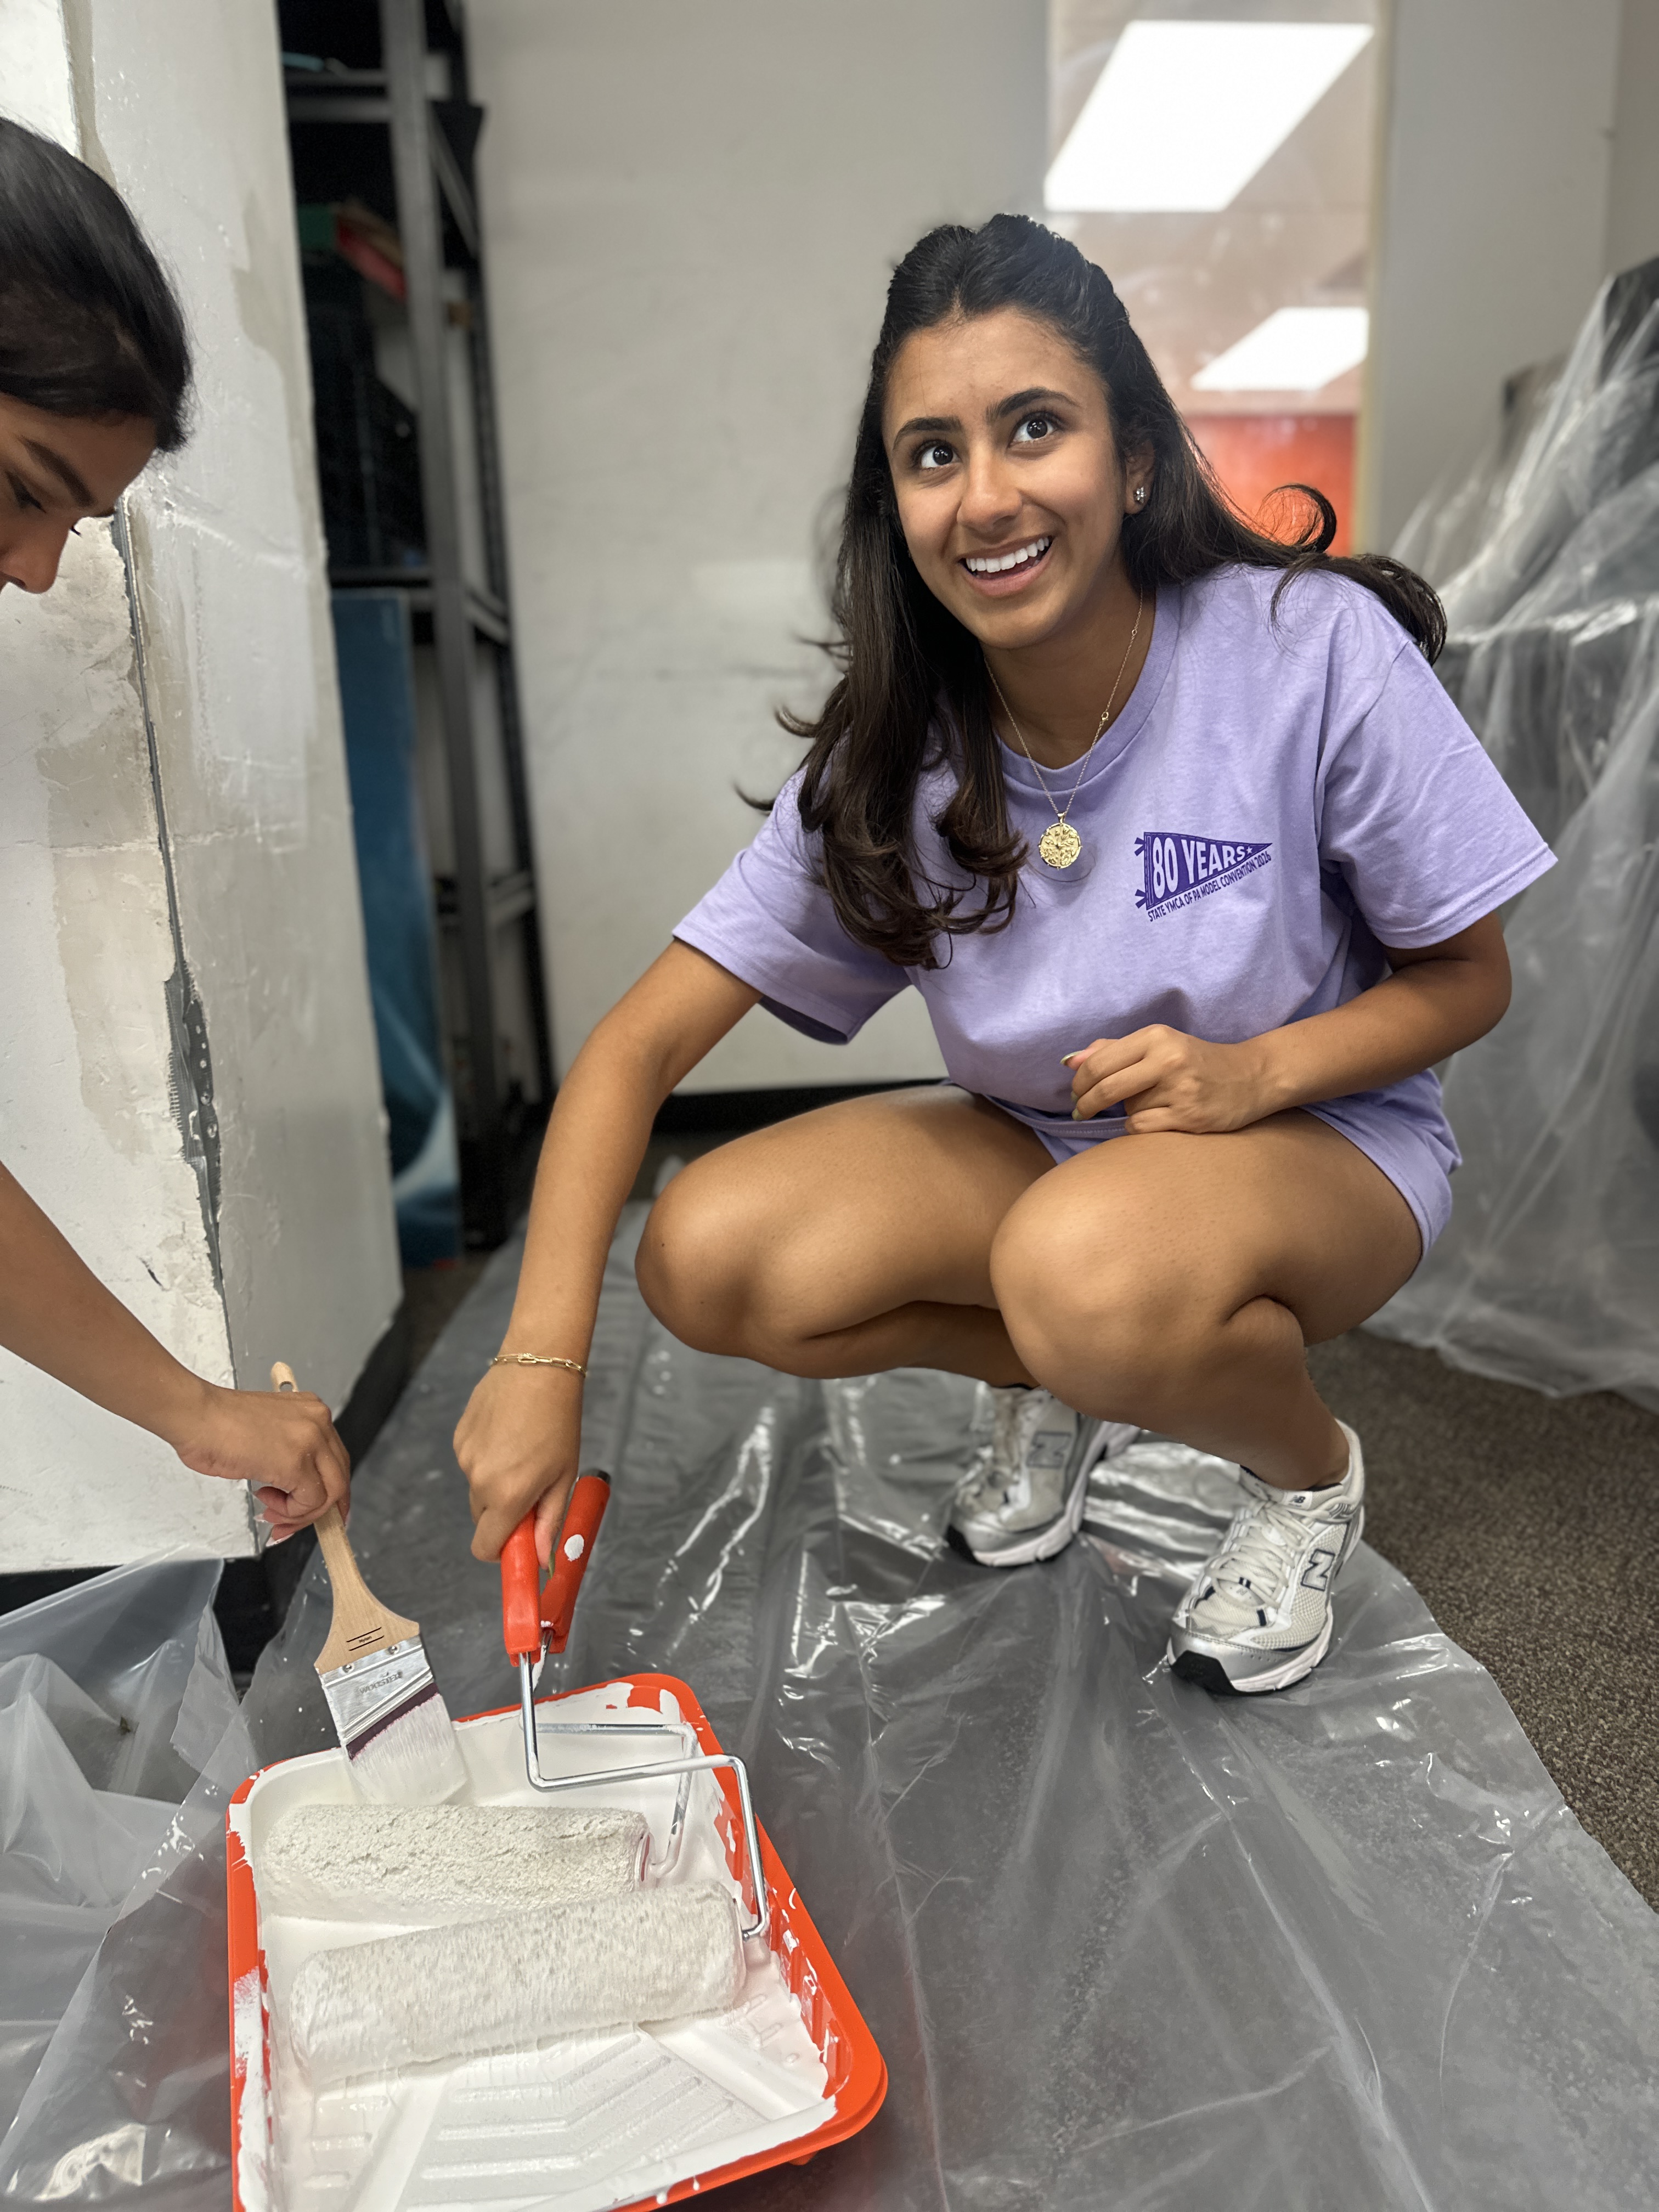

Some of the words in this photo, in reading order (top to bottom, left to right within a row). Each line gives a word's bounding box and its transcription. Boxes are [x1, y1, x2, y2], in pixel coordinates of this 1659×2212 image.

[1148, 906, 1166, 922] STATE
[1165, 896, 1185, 913] YMCA
[1185, 892, 1193, 905] OF
[1193, 888, 1201, 902] PA
[1200, 881, 1221, 898] MODEL
[1221, 860, 1257, 888] CONVENTION
[1254, 850, 1272, 868] 2026
[1152, 837, 1178, 899] 80
[1181, 839, 1245, 884] YEARS
[1300, 1549, 1335, 1592] N
